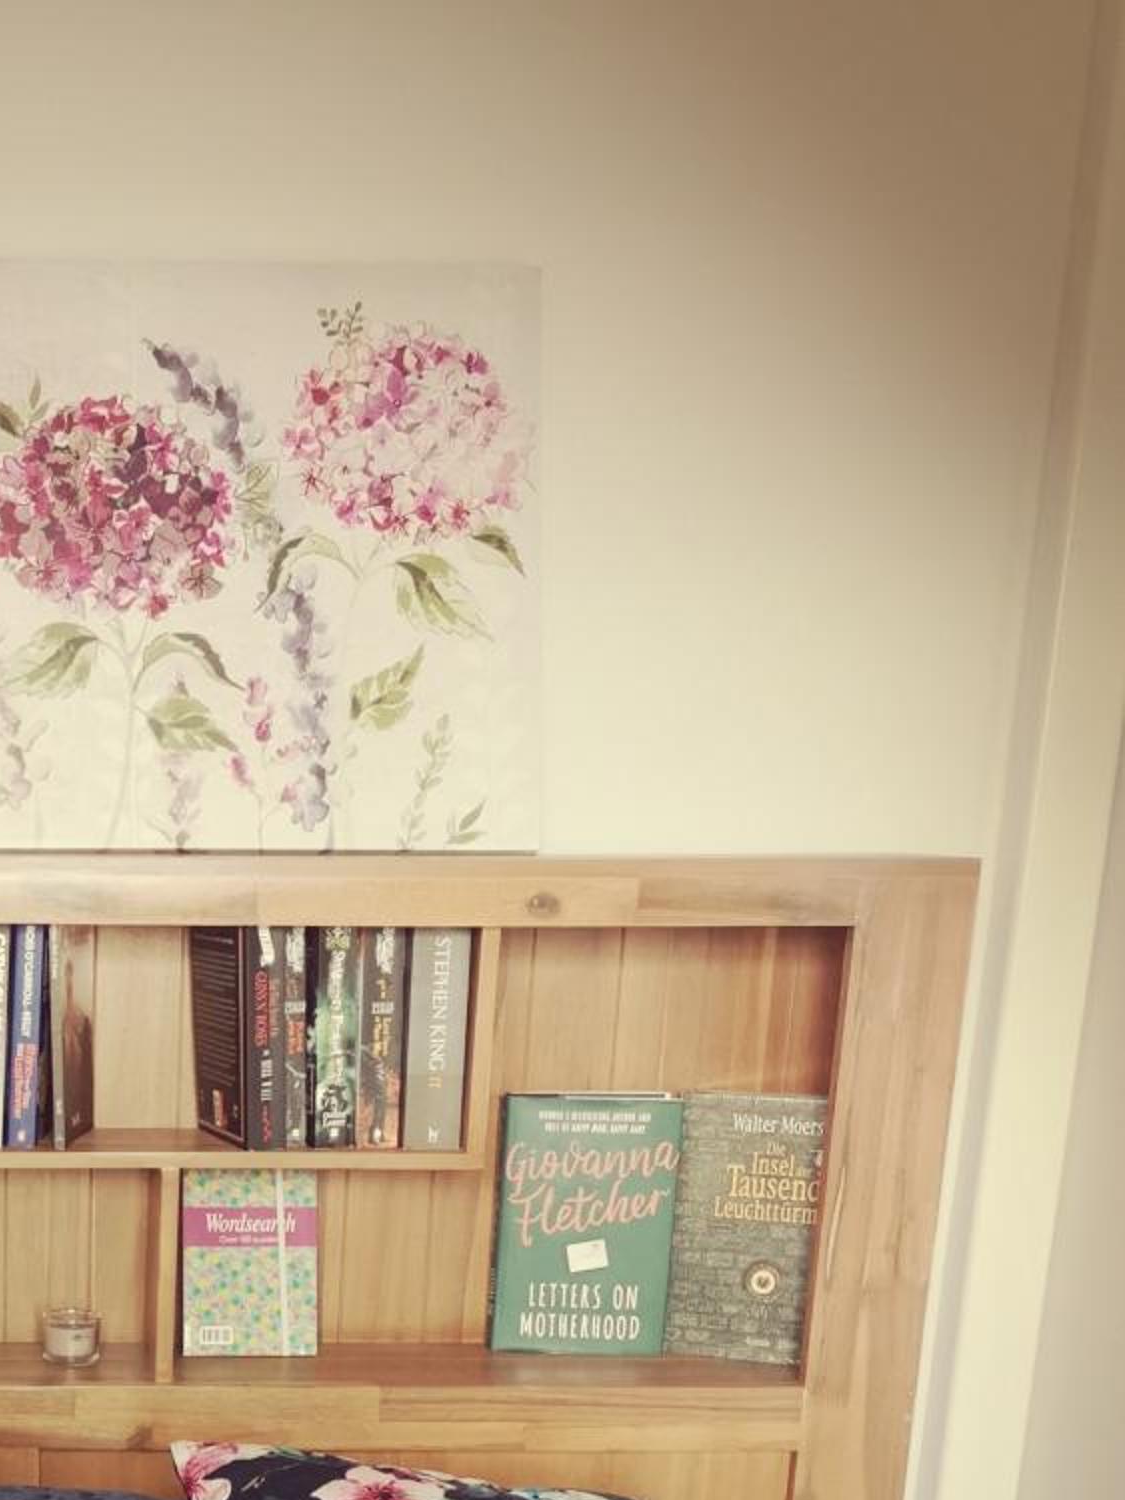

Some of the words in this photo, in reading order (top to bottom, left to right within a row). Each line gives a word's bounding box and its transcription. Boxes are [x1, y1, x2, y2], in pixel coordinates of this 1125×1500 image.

[431, 936, 452, 1019] STEPHEN
[427, 1024, 447, 1072] KING
[732, 1112, 776, 1135] Walter
[780, 1115, 825, 1137] Moers
[505, 1141, 681, 1202] Giovanna
[751, 1151, 795, 1177] Insel
[205, 1212, 297, 1233] Wordsearh
[507, 1178, 672, 1249] Fletcher
[714, 1197, 818, 1225] Leuchttürm
[527, 1282, 602, 1310] LETTERS
[612, 1284, 639, 1311] ON
[519, 1311, 641, 1341] MOTHERHOOD
